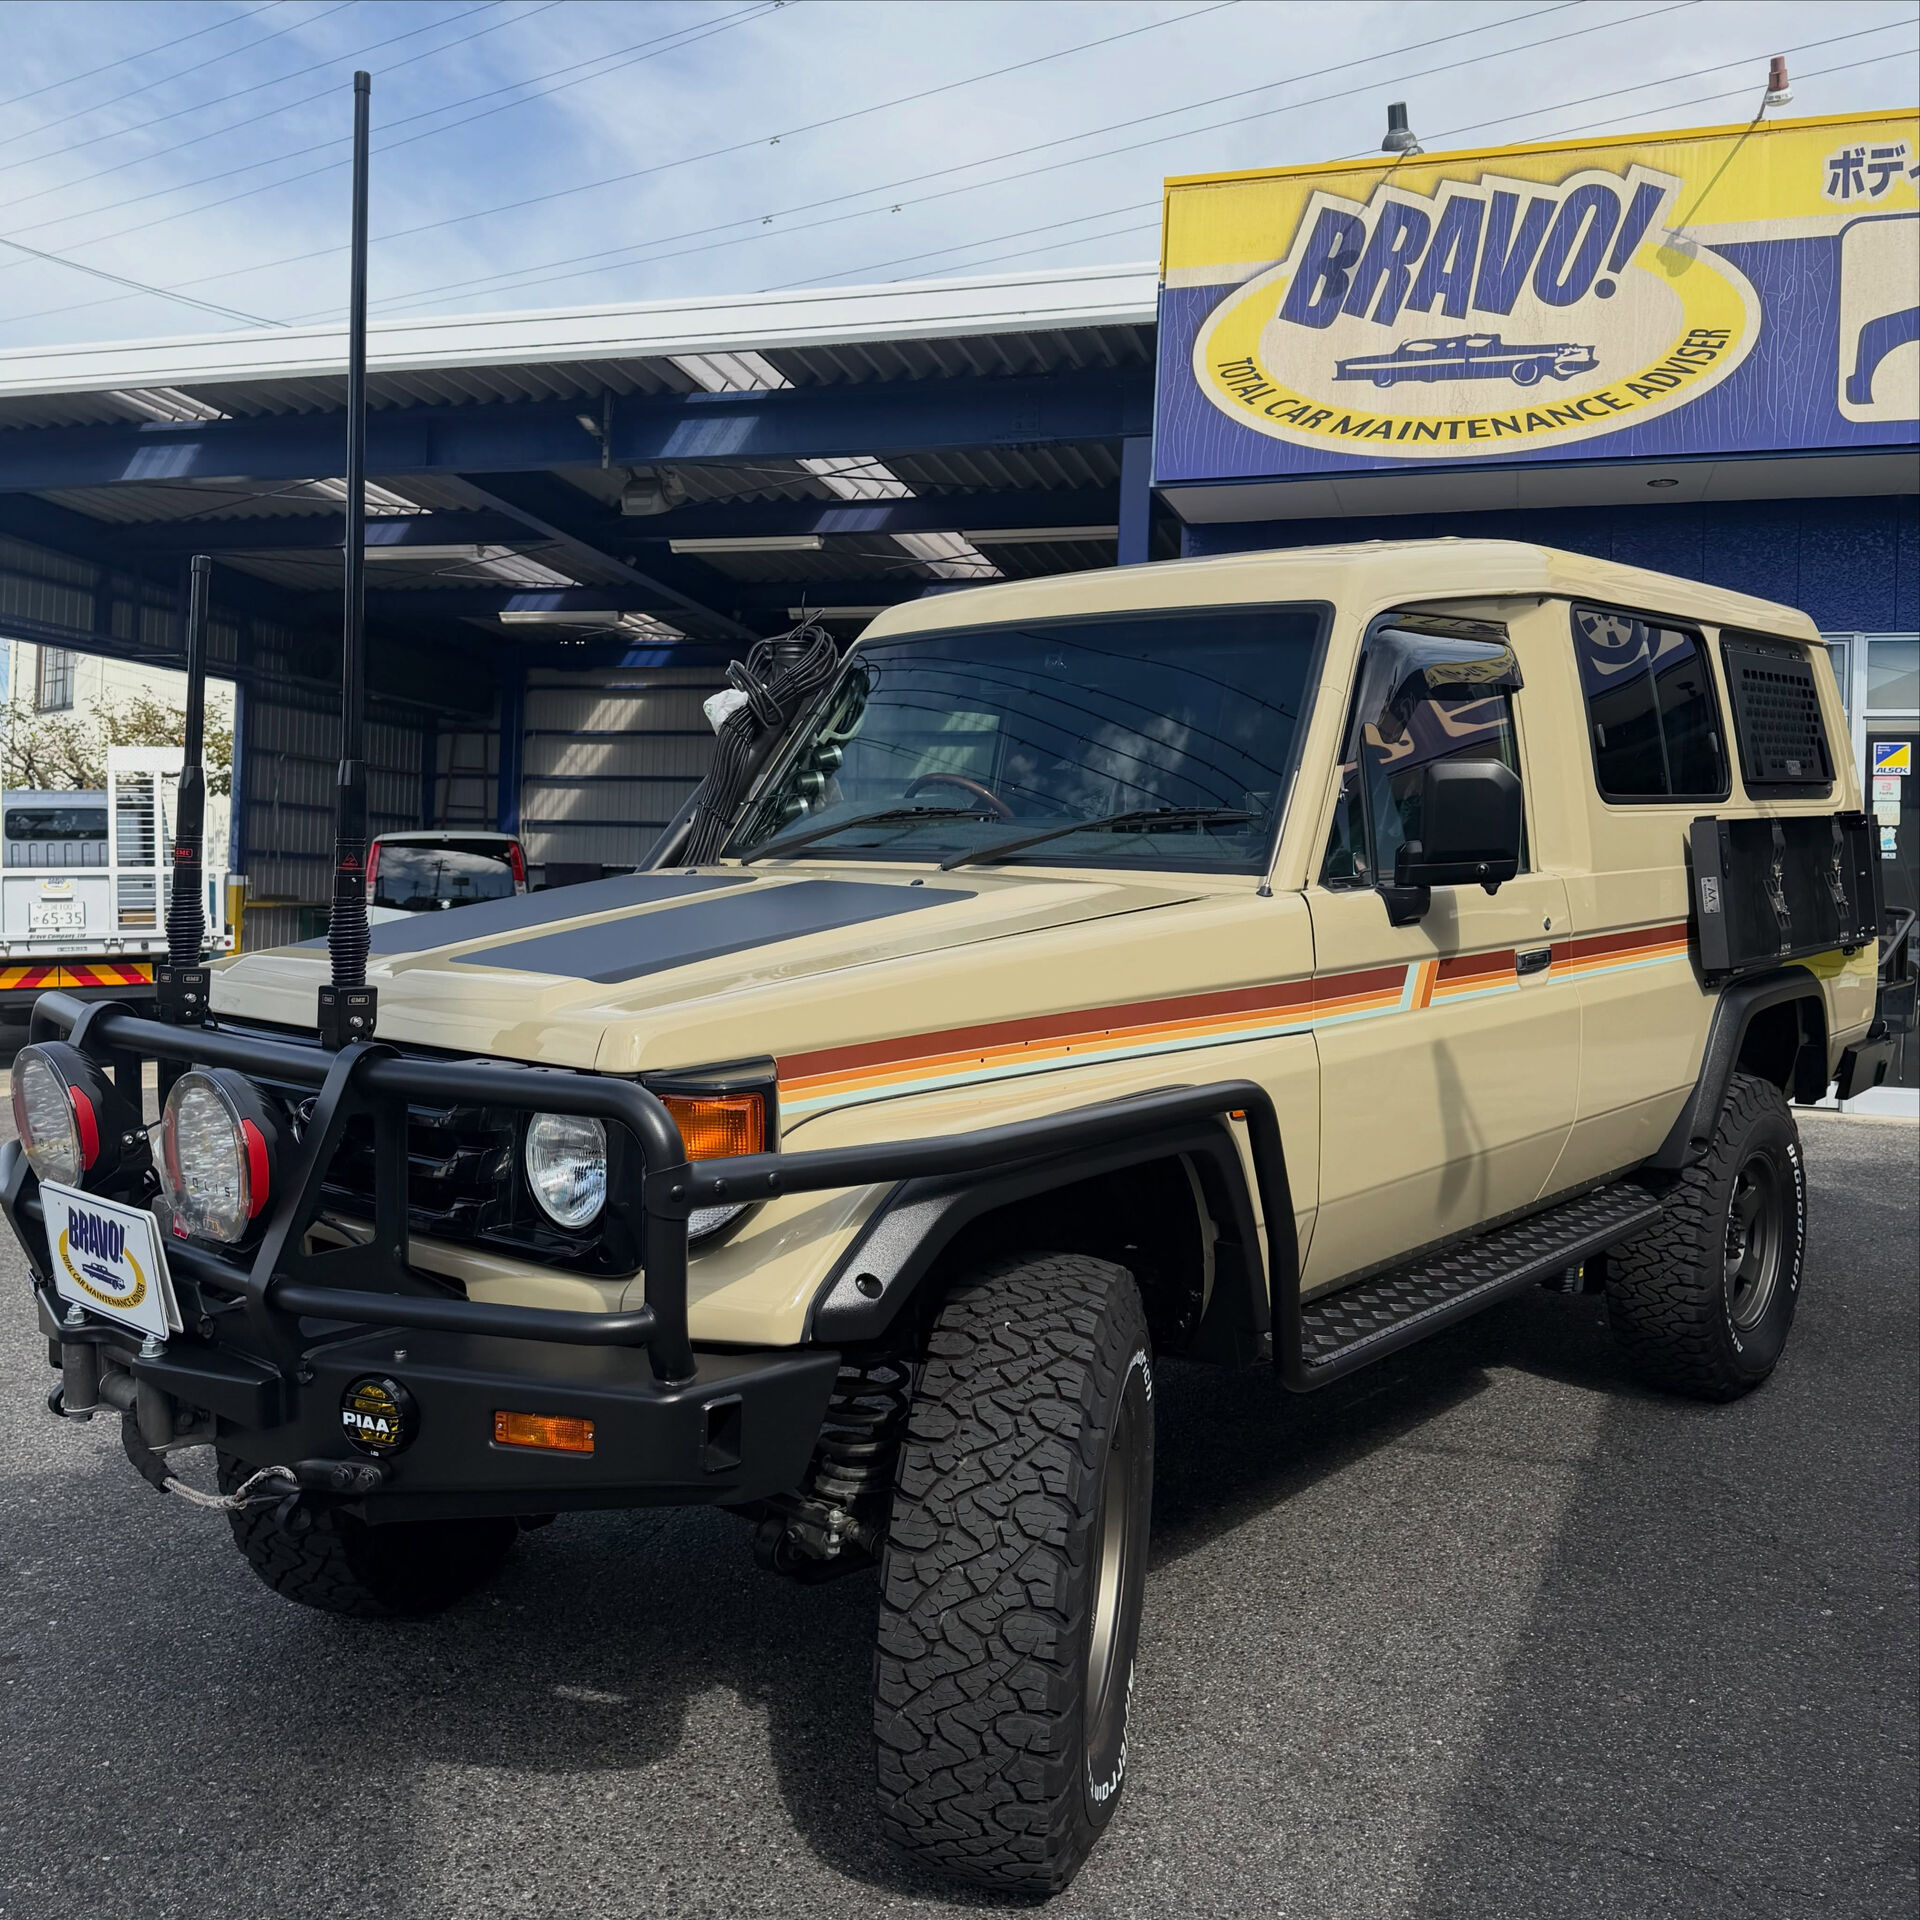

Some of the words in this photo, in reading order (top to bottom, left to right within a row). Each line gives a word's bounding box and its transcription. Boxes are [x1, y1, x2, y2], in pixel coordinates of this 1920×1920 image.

[1279, 181, 1666, 331] BRAVO!
[1217, 357, 1277, 405] TOTAL
[1263, 399, 1334, 429] CAR
[1328, 392, 1634, 440] MAINTENANCE
[1625, 329, 1732, 399] ADVISER
[42, 912, 82, 925] 65-35
[68, 1206, 125, 1264] BRAVO!
[85, 1285, 133, 1308] MAINTENANCE
[342, 1411, 390, 1433] PIAA
